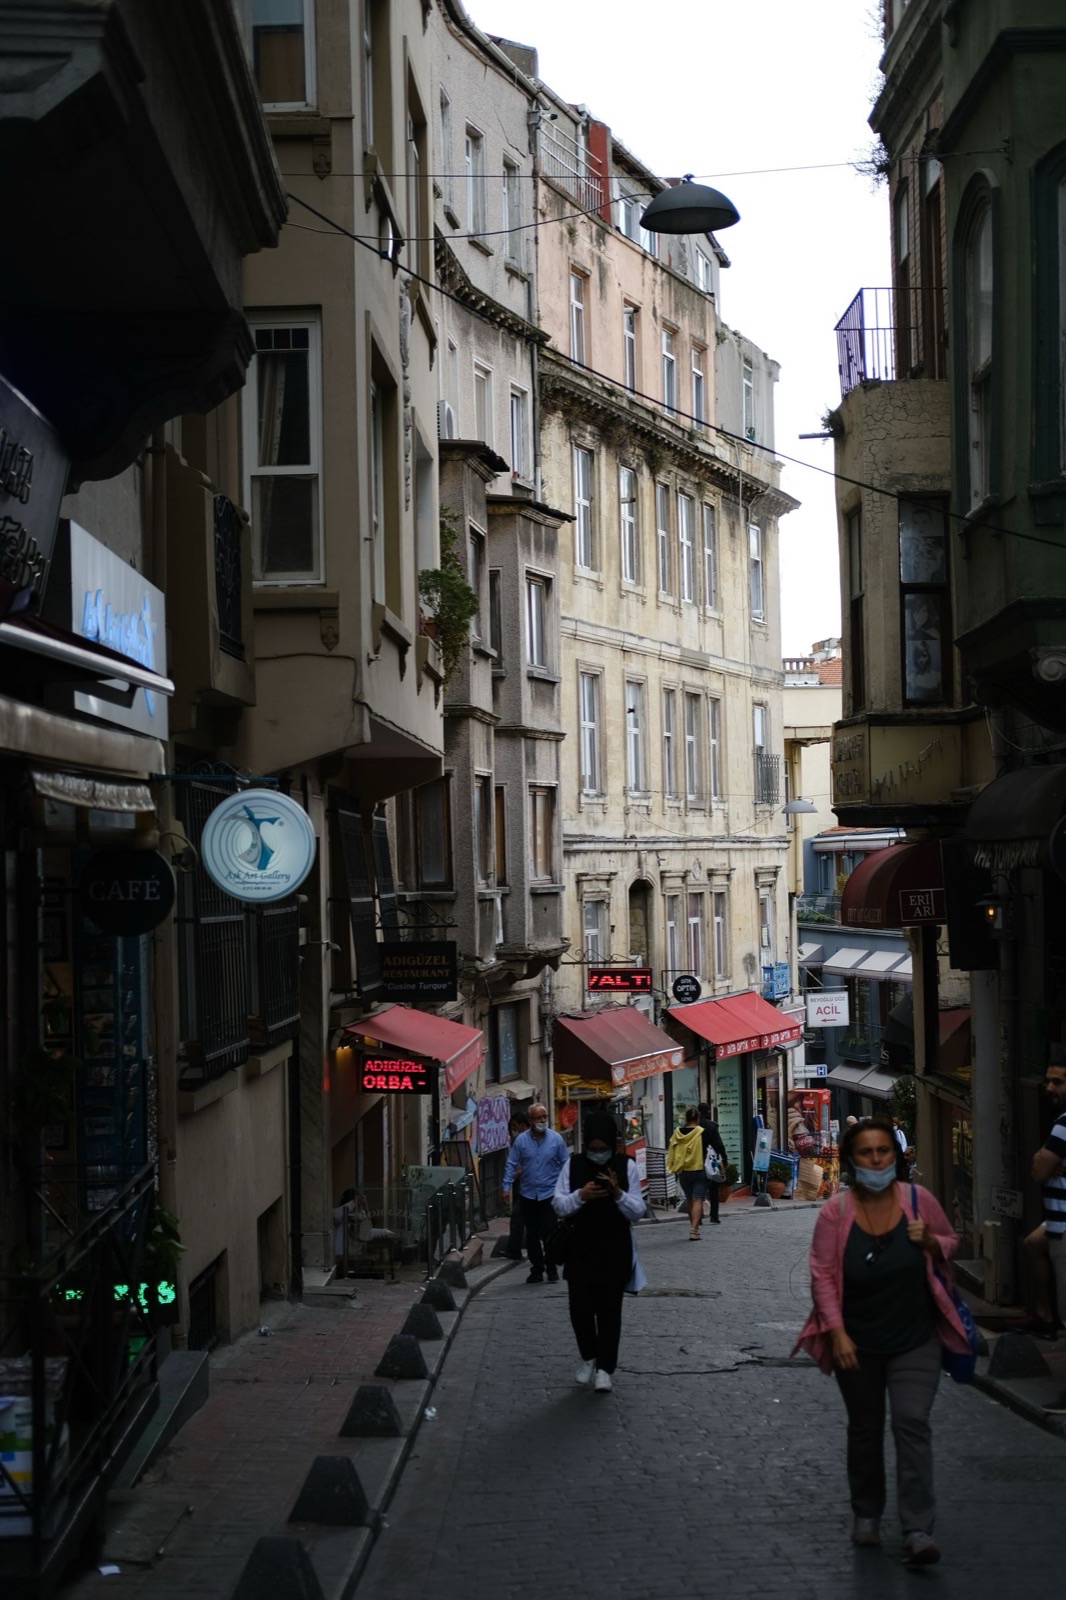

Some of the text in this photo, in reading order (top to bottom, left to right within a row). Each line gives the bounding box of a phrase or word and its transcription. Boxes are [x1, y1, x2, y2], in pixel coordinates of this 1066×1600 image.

[243, 870, 258, 880] Art
[260, 870, 291, 883] Gallery
[88, 873, 161, 901] CAFÉ
[384, 952, 449, 966] ADIGÜZEL
[816, 1004, 841, 1015] ACİL
